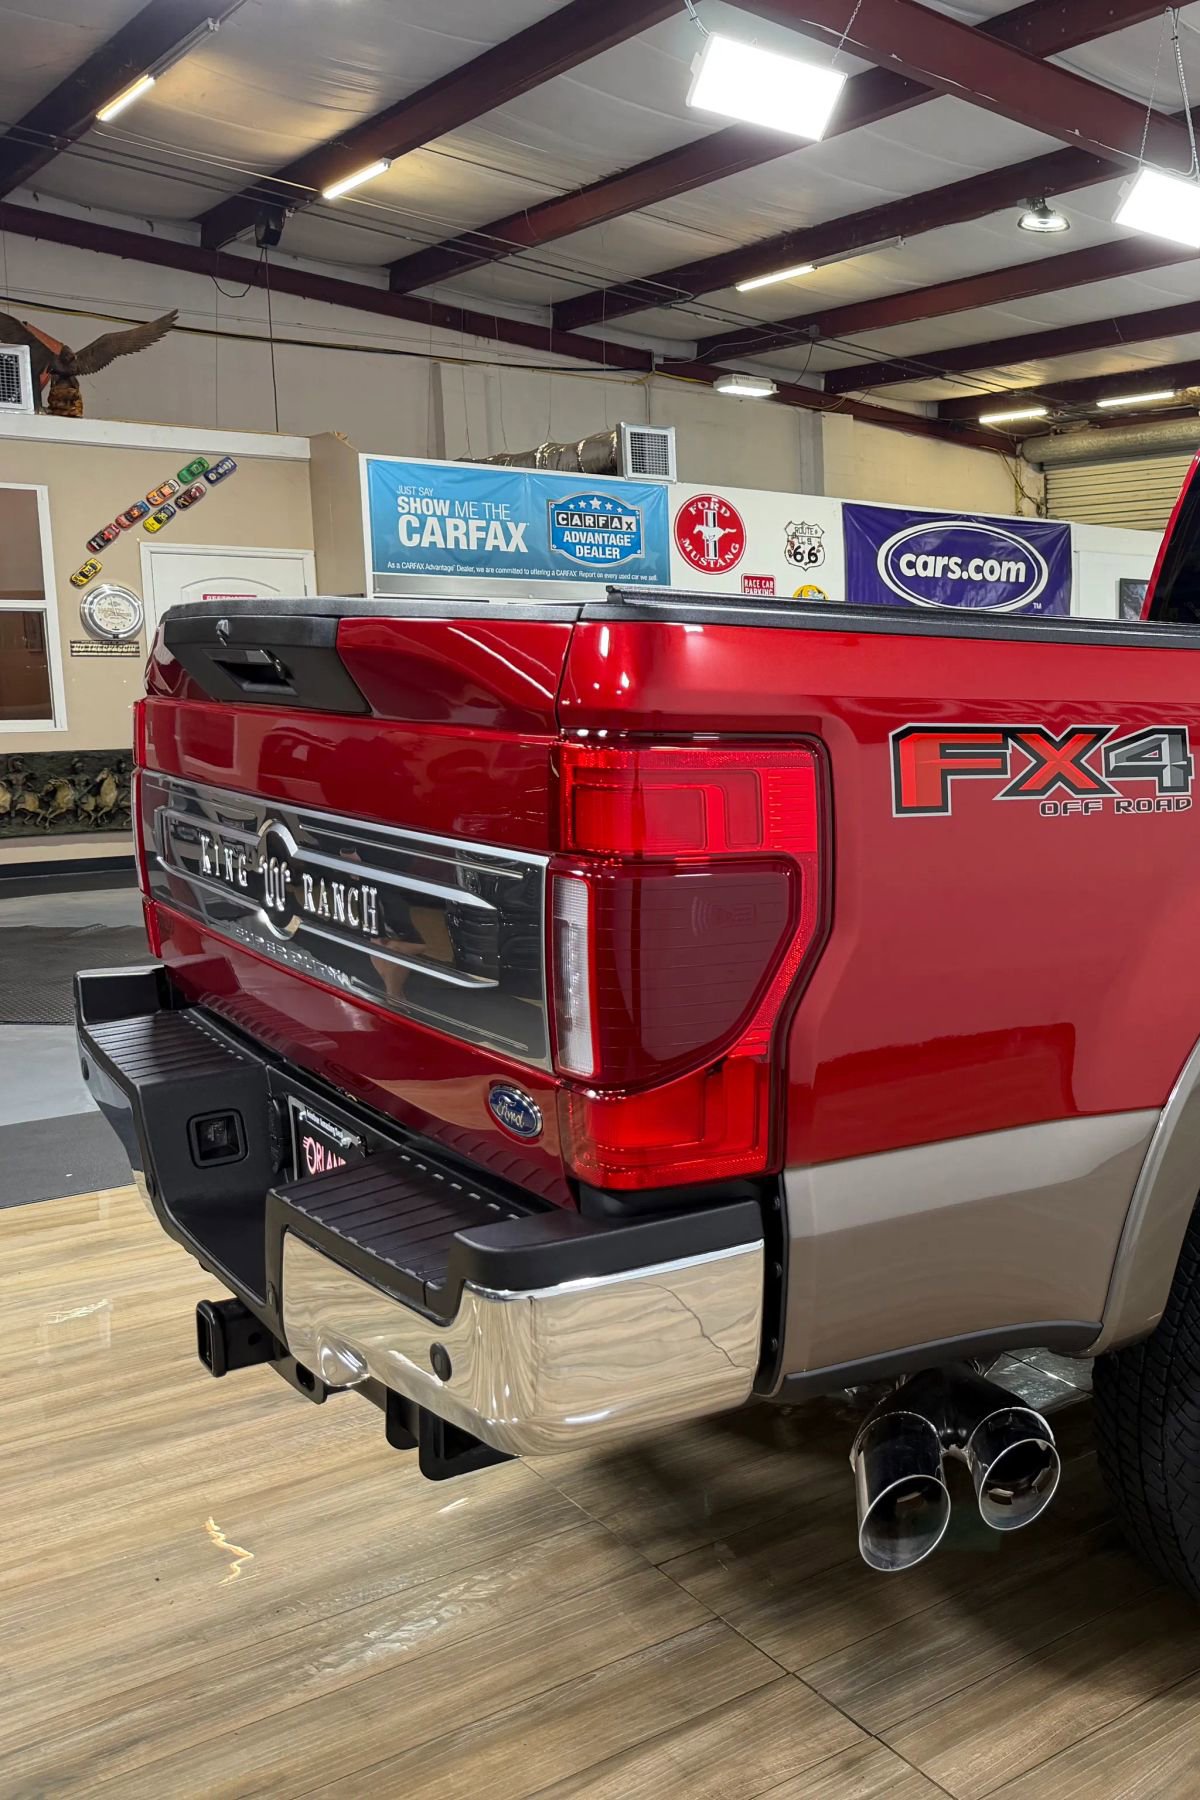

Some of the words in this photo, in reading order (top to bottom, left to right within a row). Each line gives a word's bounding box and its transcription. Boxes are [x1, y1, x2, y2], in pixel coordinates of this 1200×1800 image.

[396, 485, 415, 496] JUST
[418, 487, 433, 497] SAY
[397, 496, 450, 516] SHOW
[455, 501, 479, 519] ME
[482, 503, 511, 521] THE
[688, 501, 730, 517] FORD
[558, 513, 634, 531] CARFAX
[795, 526, 814, 536] ROUTE
[398, 514, 528, 552] CARFAX
[563, 530, 632, 547] ADVANTAGE
[575, 545, 621, 559] DEALER
[681, 538, 740, 568] MUSTANG
[793, 545, 818, 564] 66
[388, 561, 395, 569] As
[401, 562, 425, 570] CARFAX
[425, 563, 455, 572] Advantage
[457, 565, 476, 574] Dealer,
[495, 566, 523, 575] committed
[556, 569, 577, 577] CARFAX
[579, 570, 596, 579] Report
[899, 553, 1026, 583] cars.com
[744, 579, 760, 588] RACE
[762, 580, 774, 588] CAR
[745, 588, 775, 596] PARKING
[889, 723, 1195, 817] FX4
[1039, 800, 1103, 816] OFF
[1114, 796, 1193, 815] ROAD
[201, 835, 249, 887] KING
[302, 873, 378, 936] RANCH
[497, 1095, 526, 1129] Ford
